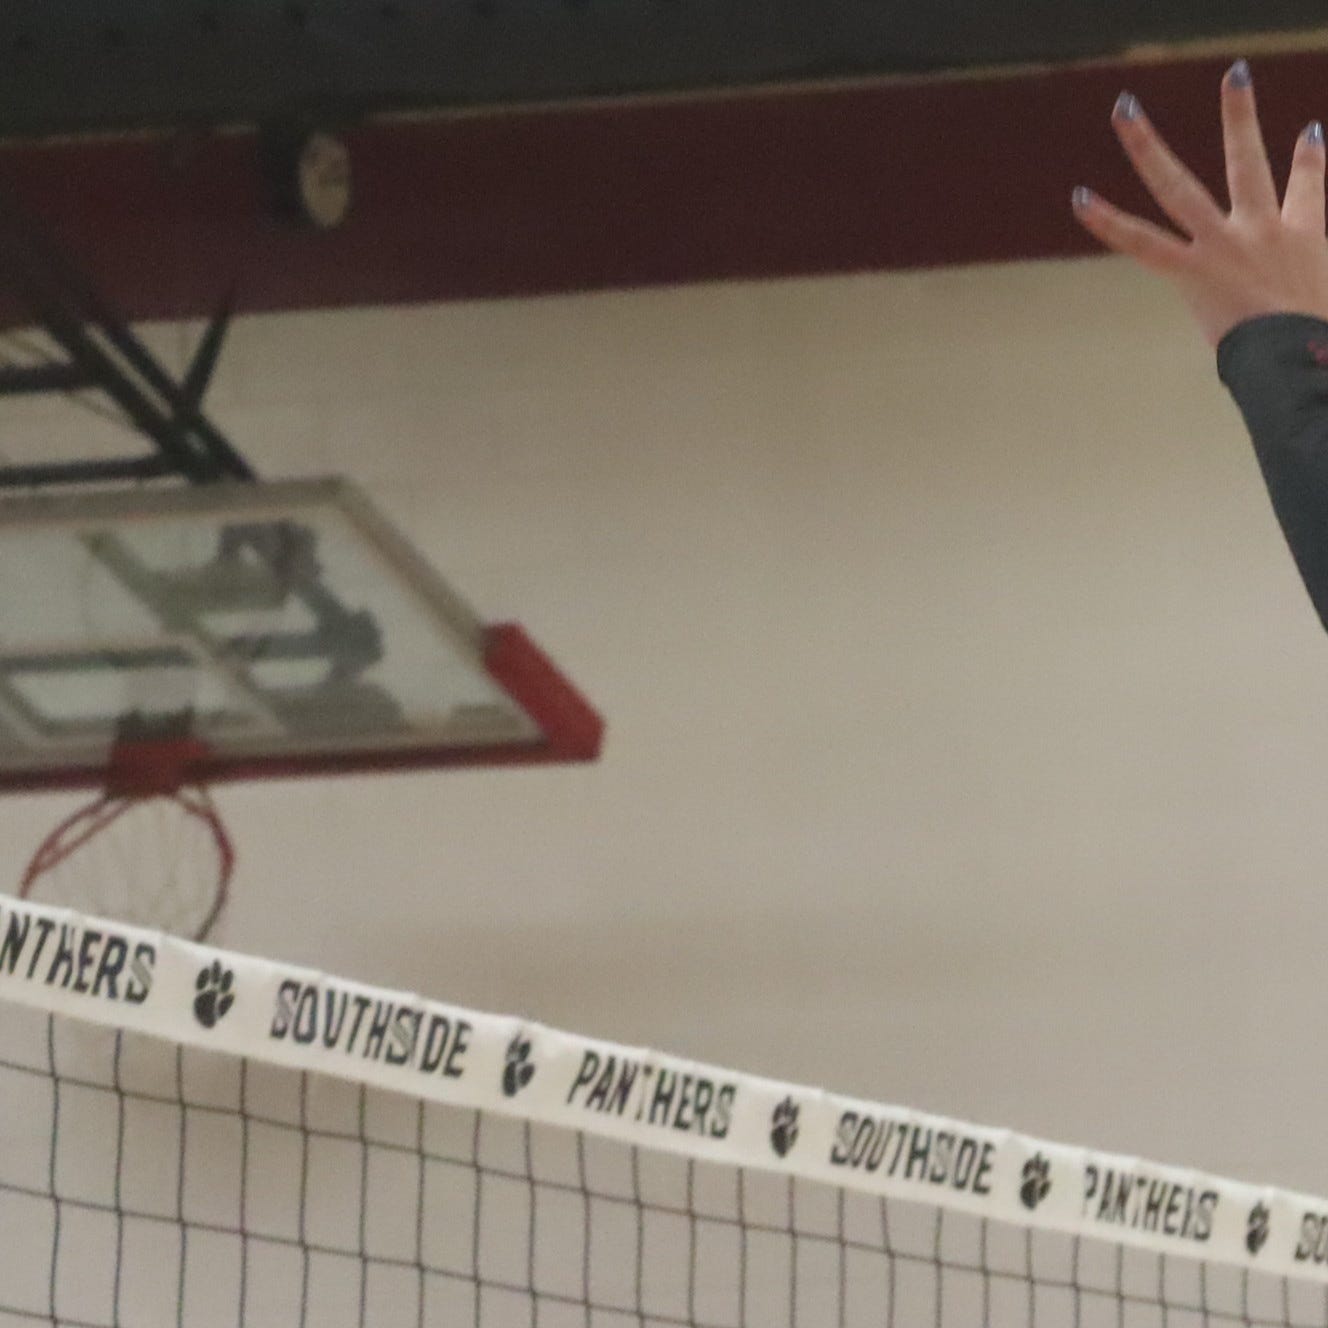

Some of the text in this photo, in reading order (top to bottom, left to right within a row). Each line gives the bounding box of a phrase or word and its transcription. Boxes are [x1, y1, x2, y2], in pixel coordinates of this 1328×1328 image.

[0, 910, 156, 1005] NTHERS
[268, 979, 471, 1079] SOUTHSIDE
[567, 1049, 736, 1140] PANTHERS
[829, 1110, 997, 1196] SOUTHSIDE
